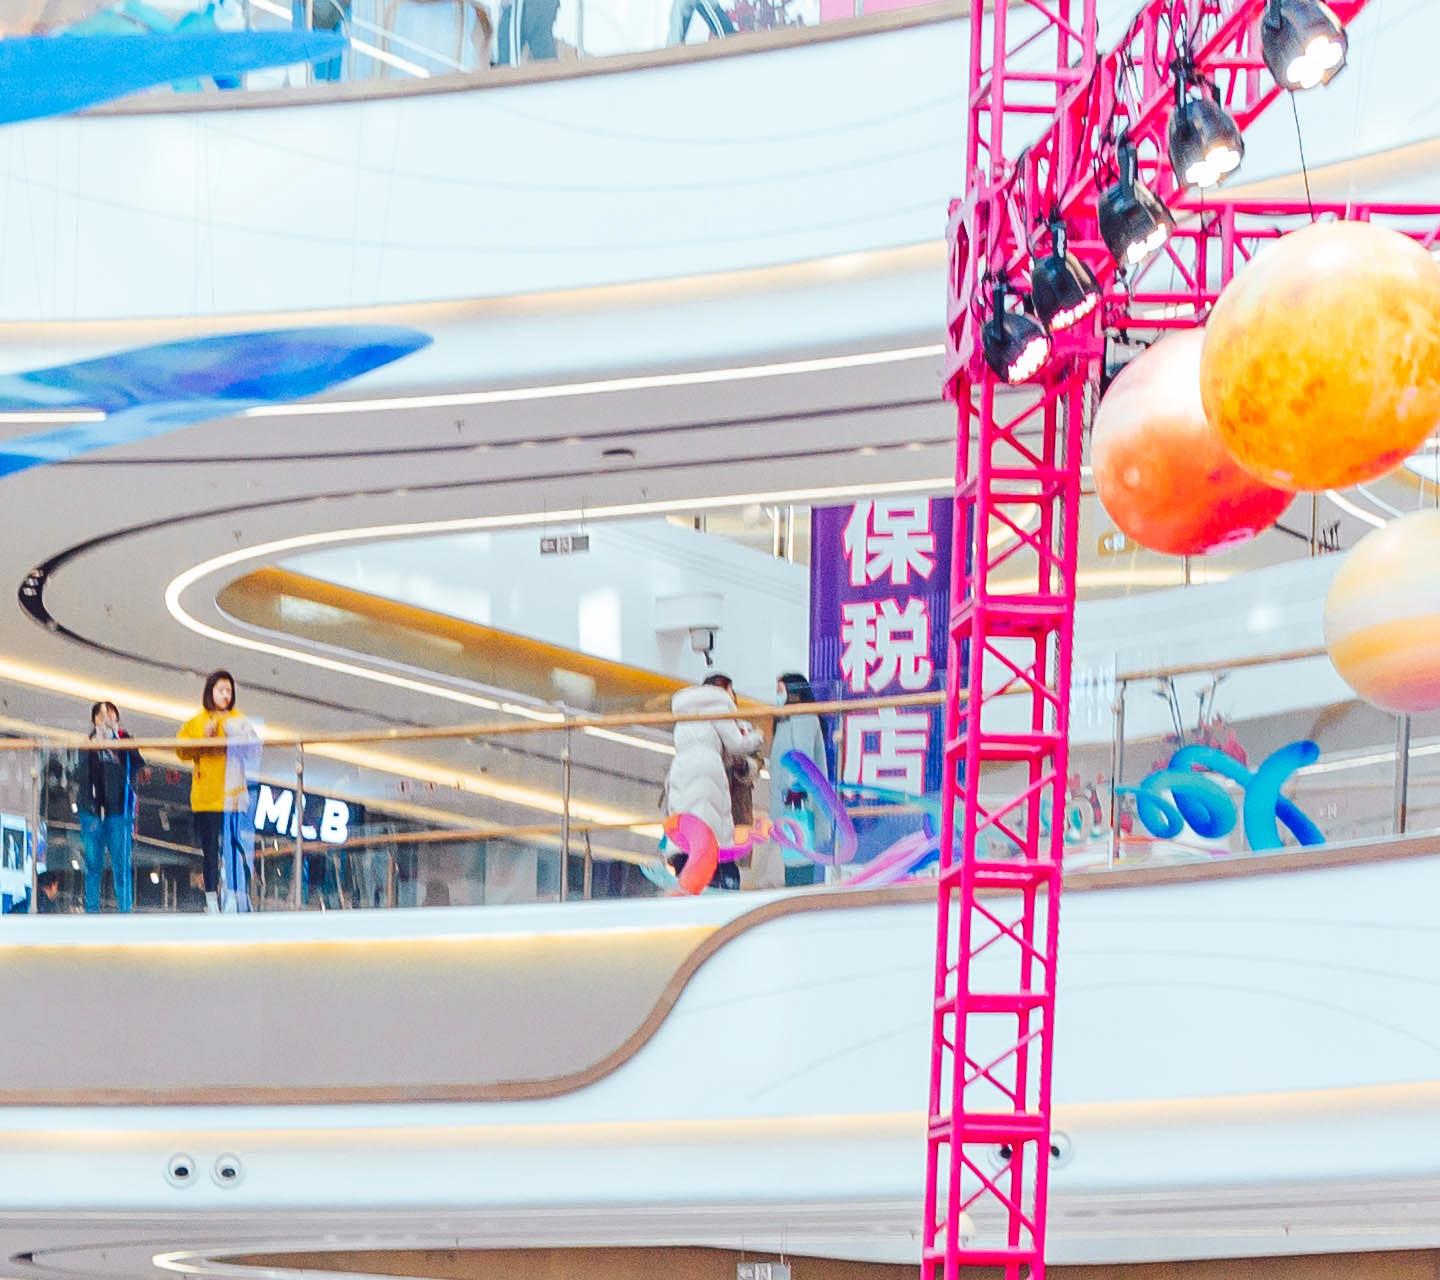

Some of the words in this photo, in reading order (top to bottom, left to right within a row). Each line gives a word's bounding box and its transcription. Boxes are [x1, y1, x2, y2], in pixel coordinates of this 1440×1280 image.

[841, 500, 936, 800] 保税店
[254, 784, 350, 844] MLB
